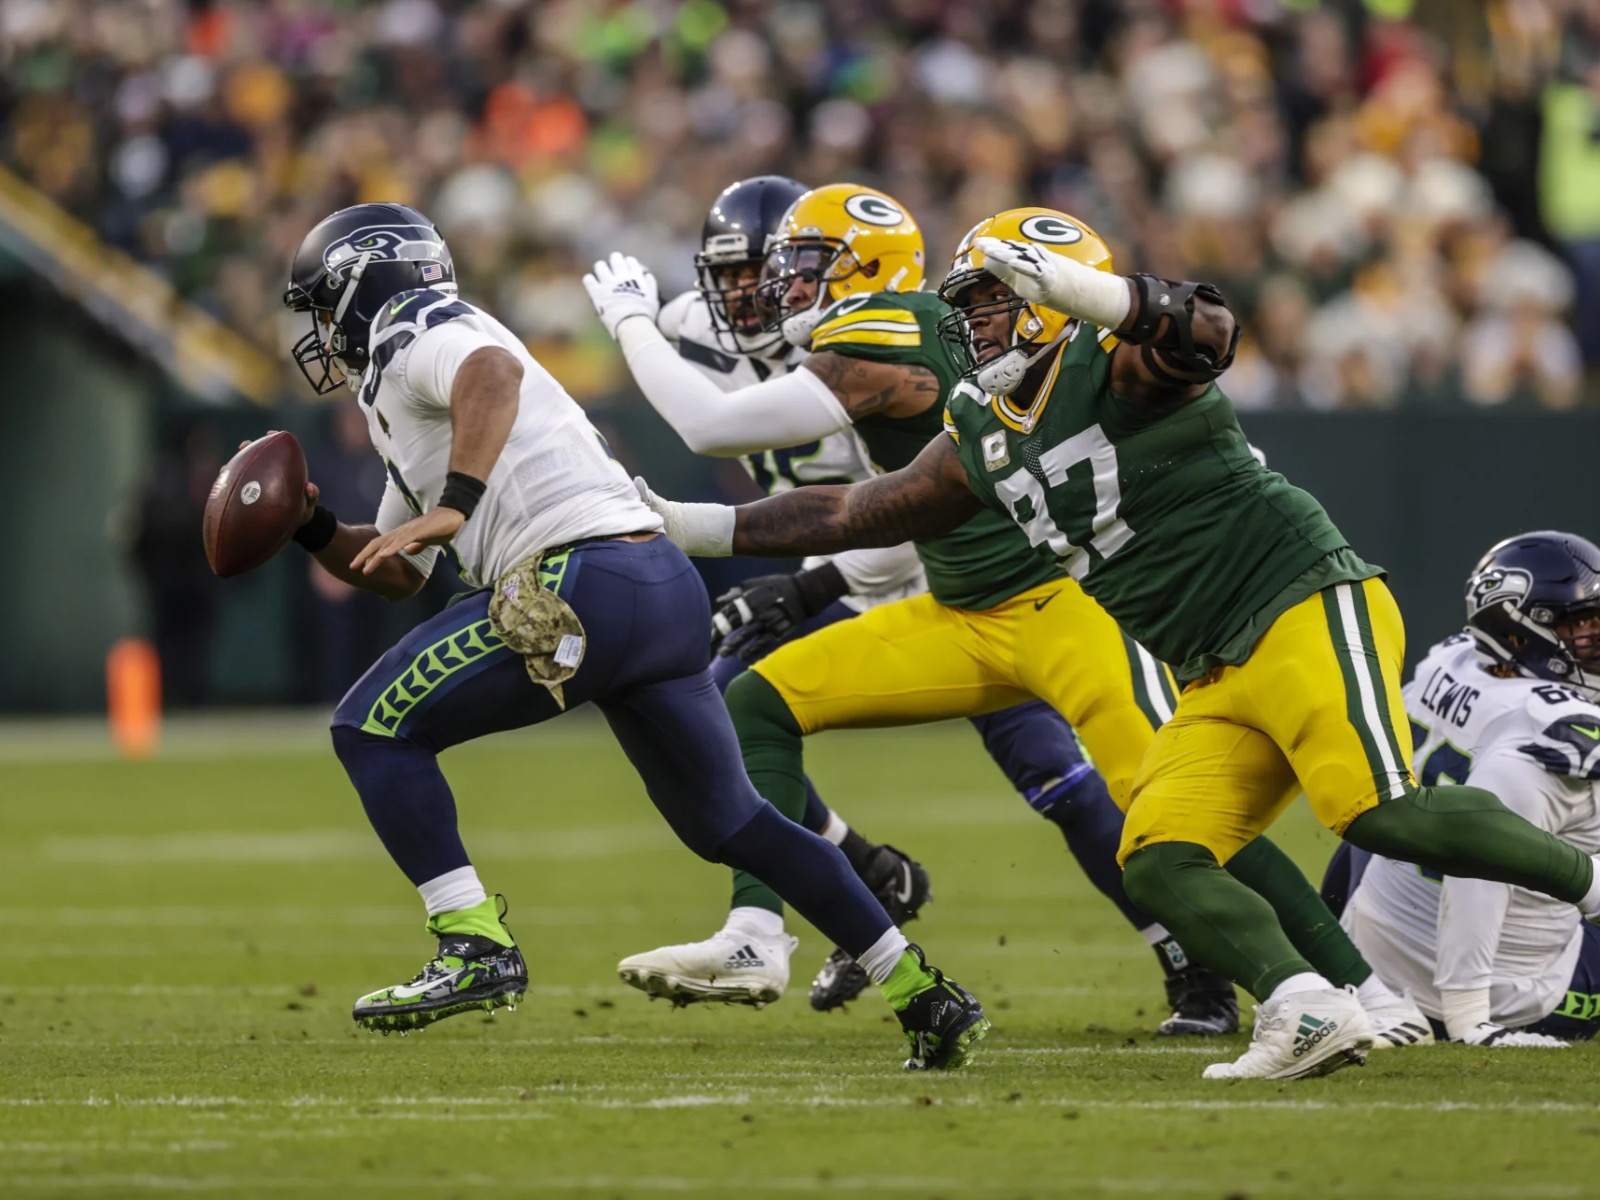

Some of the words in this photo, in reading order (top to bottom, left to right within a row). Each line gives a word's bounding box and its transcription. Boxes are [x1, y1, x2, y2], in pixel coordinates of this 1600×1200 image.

[844, 194, 905, 227] G
[1019, 215, 1083, 245] G
[983, 432, 1007, 461] C
[994, 423, 1137, 582] 97
[1420, 666, 1480, 728] LEWIS
[724, 959, 765, 970] adidas
[1293, 1021, 1338, 1057] adidas
